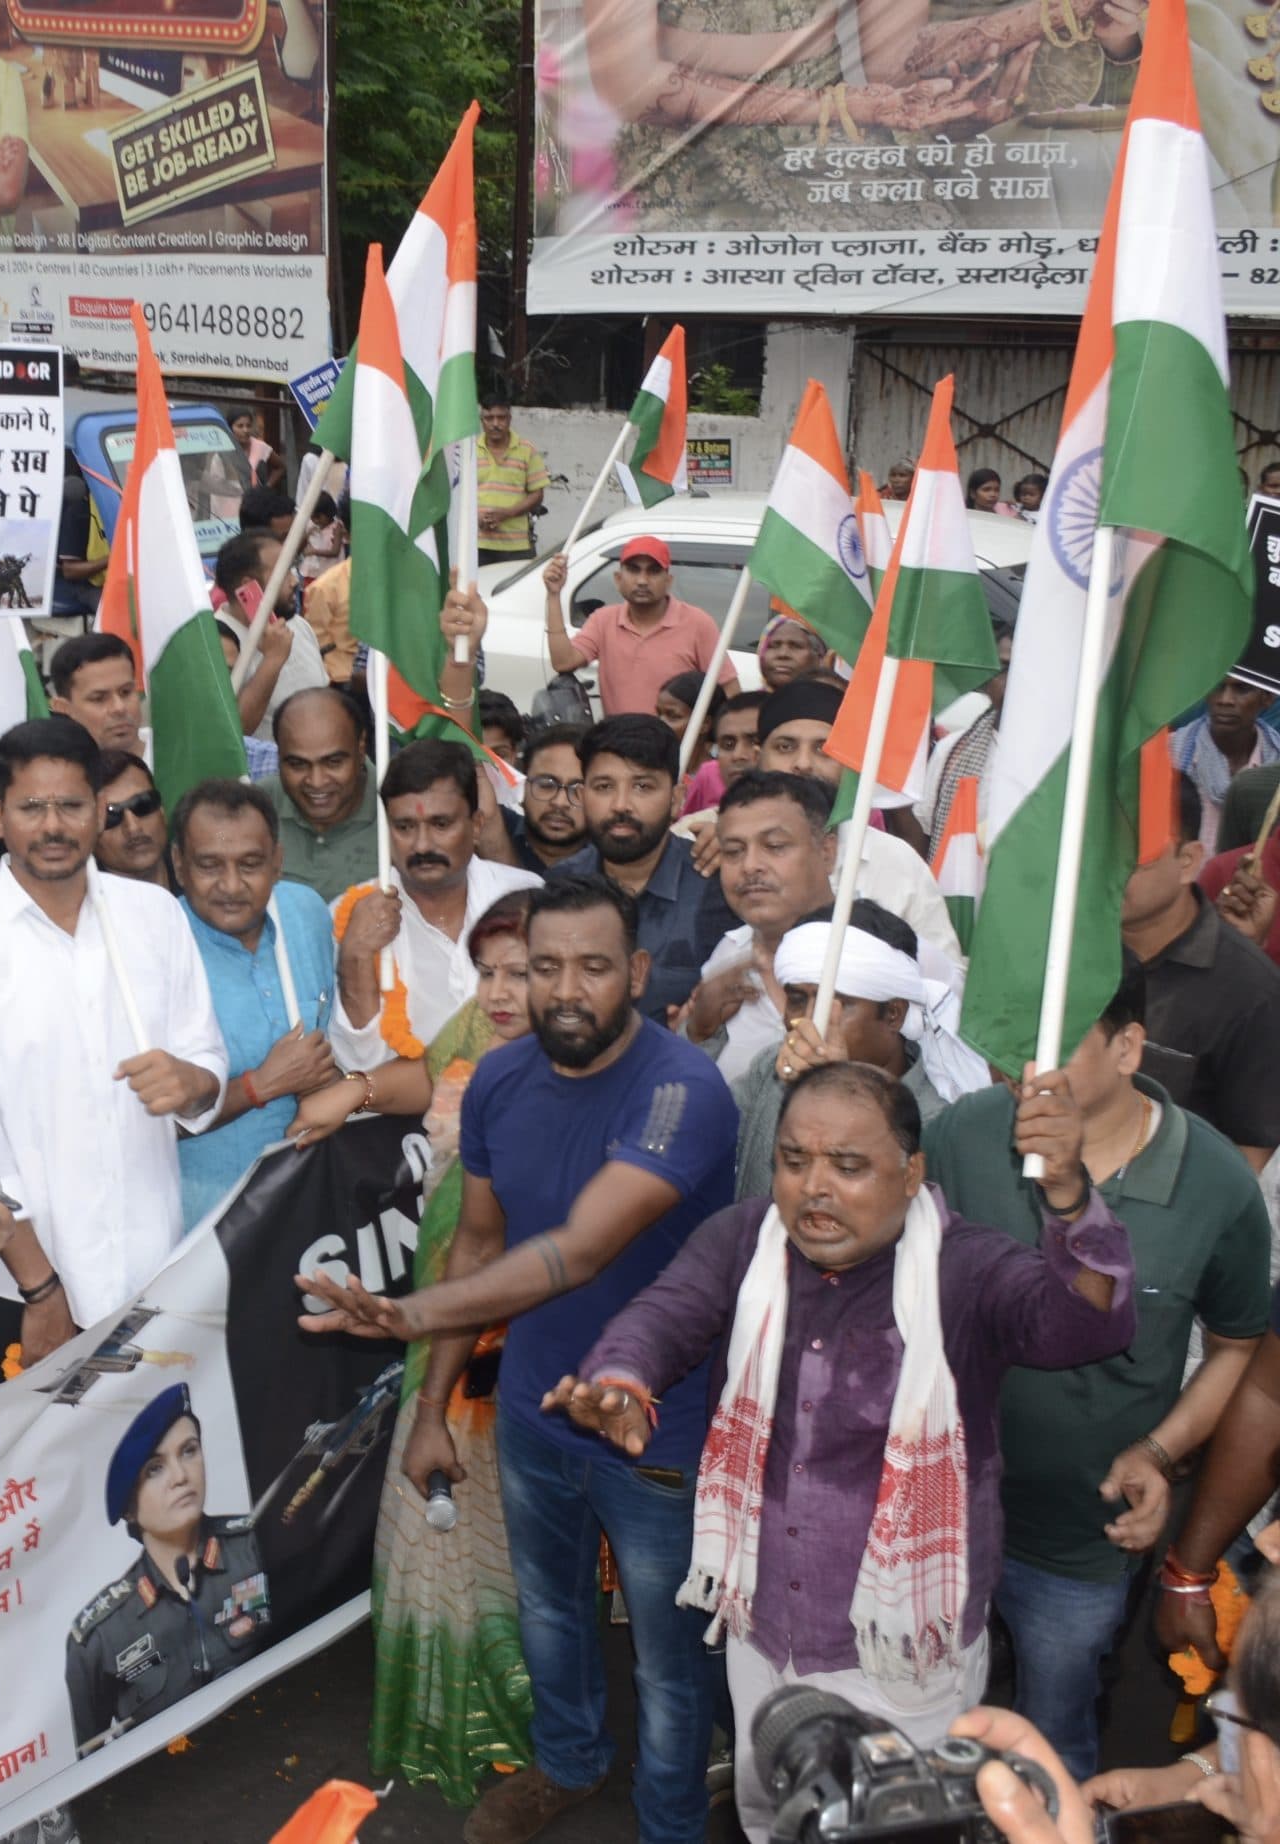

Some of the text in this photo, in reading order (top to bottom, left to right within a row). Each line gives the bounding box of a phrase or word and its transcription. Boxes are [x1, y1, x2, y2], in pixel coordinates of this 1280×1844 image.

[120, 93, 256, 170] GET SKILLED &
[124, 119, 258, 199] BE JOB-READY
[783, 134, 1078, 179] हर दुल्हन को हो नाज़,
[807, 169, 1052, 203] जब कला बने साज
[14, 233, 47, 251] Design
[57, 234, 71, 248] XR
[77, 233, 111, 250] Digital
[112, 233, 156, 248] Content
[157, 232, 208, 247] Creation
[216, 231, 263, 250] Graphic
[265, 232, 309, 251] Design
[614, 234, 697, 256] शोरुम
[725, 234, 823, 256] ओजोन
[831, 237, 925, 257] प्लाजा,
[937, 231, 991, 255] बैंक
[999, 231, 1064, 259] मोड़,
[36, 263, 70, 275] Centres
[79, 264, 91, 276] 40
[92, 263, 138, 277] Countries
[155, 262, 184, 277] Lakh+
[187, 262, 250, 278] Placements
[252, 263, 313, 280] Worldwide
[591, 264, 675, 285] शोरुम
[702, 268, 786, 285] आस्था
[793, 262, 865, 292] ट्विन
[872, 263, 944, 286] टॉवर,
[73, 300, 131, 316] Enquire Now
[142, 302, 305, 340] 9641488882
[92, 349, 138, 364] Bandhan
[236, 352, 289, 372] Dhanbad
[38, 407, 56, 436] पे,
[10, 448, 50, 473] सब
[18, 485, 41, 518] पे
[22, 1516, 41, 1553] में
